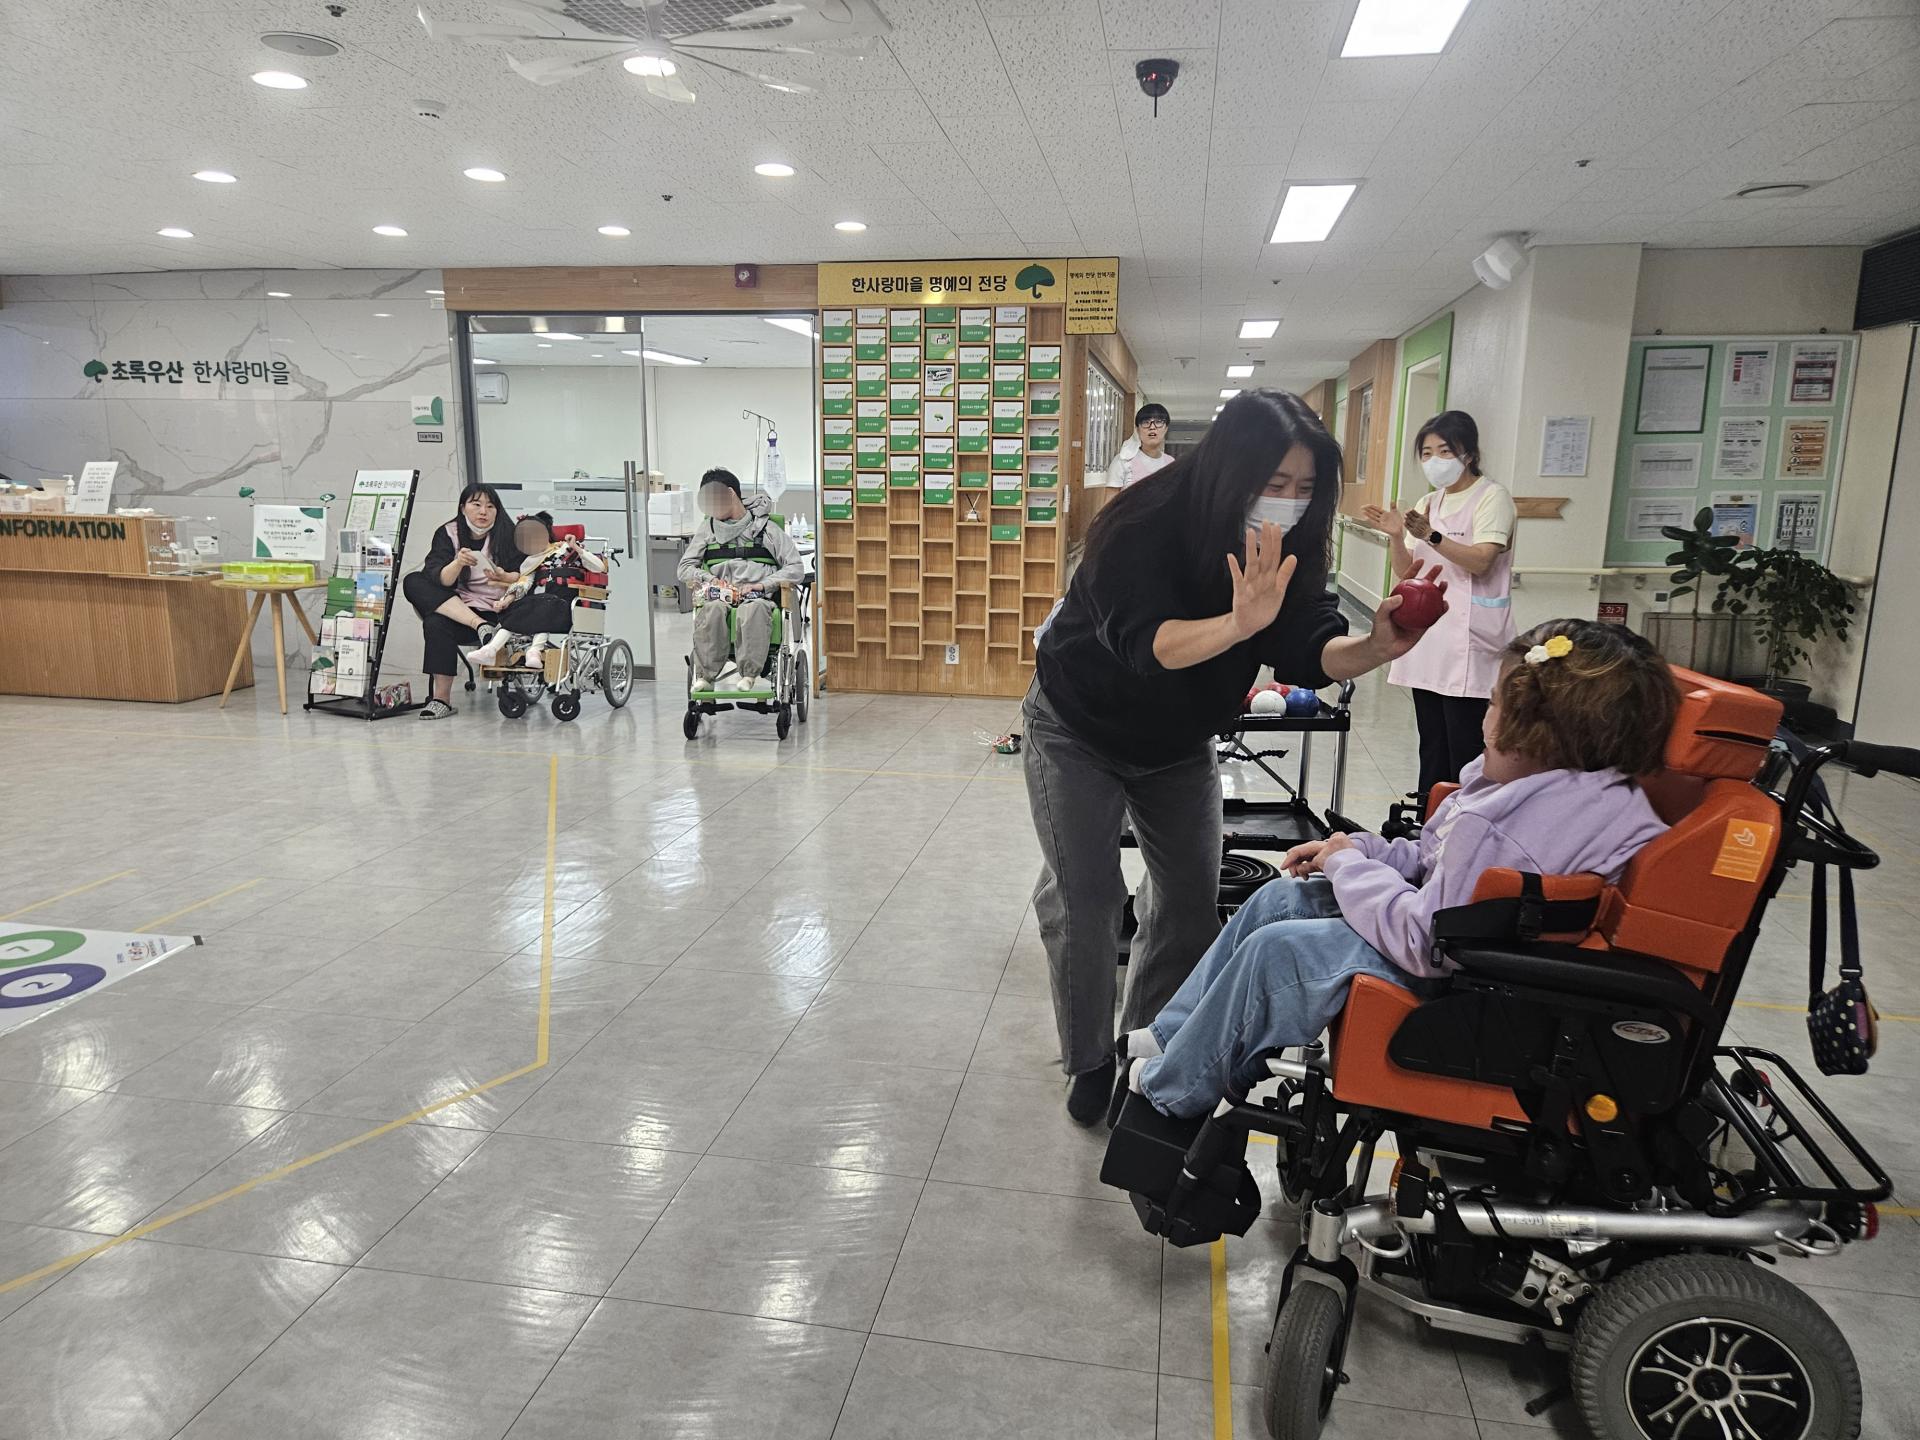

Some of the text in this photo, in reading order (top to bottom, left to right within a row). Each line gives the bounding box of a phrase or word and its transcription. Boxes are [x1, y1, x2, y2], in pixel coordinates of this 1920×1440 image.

[851, 275, 1008, 294] 한사랑마을 명예의 전당
[111, 360, 290, 385] 초록우산 한사랑마을
